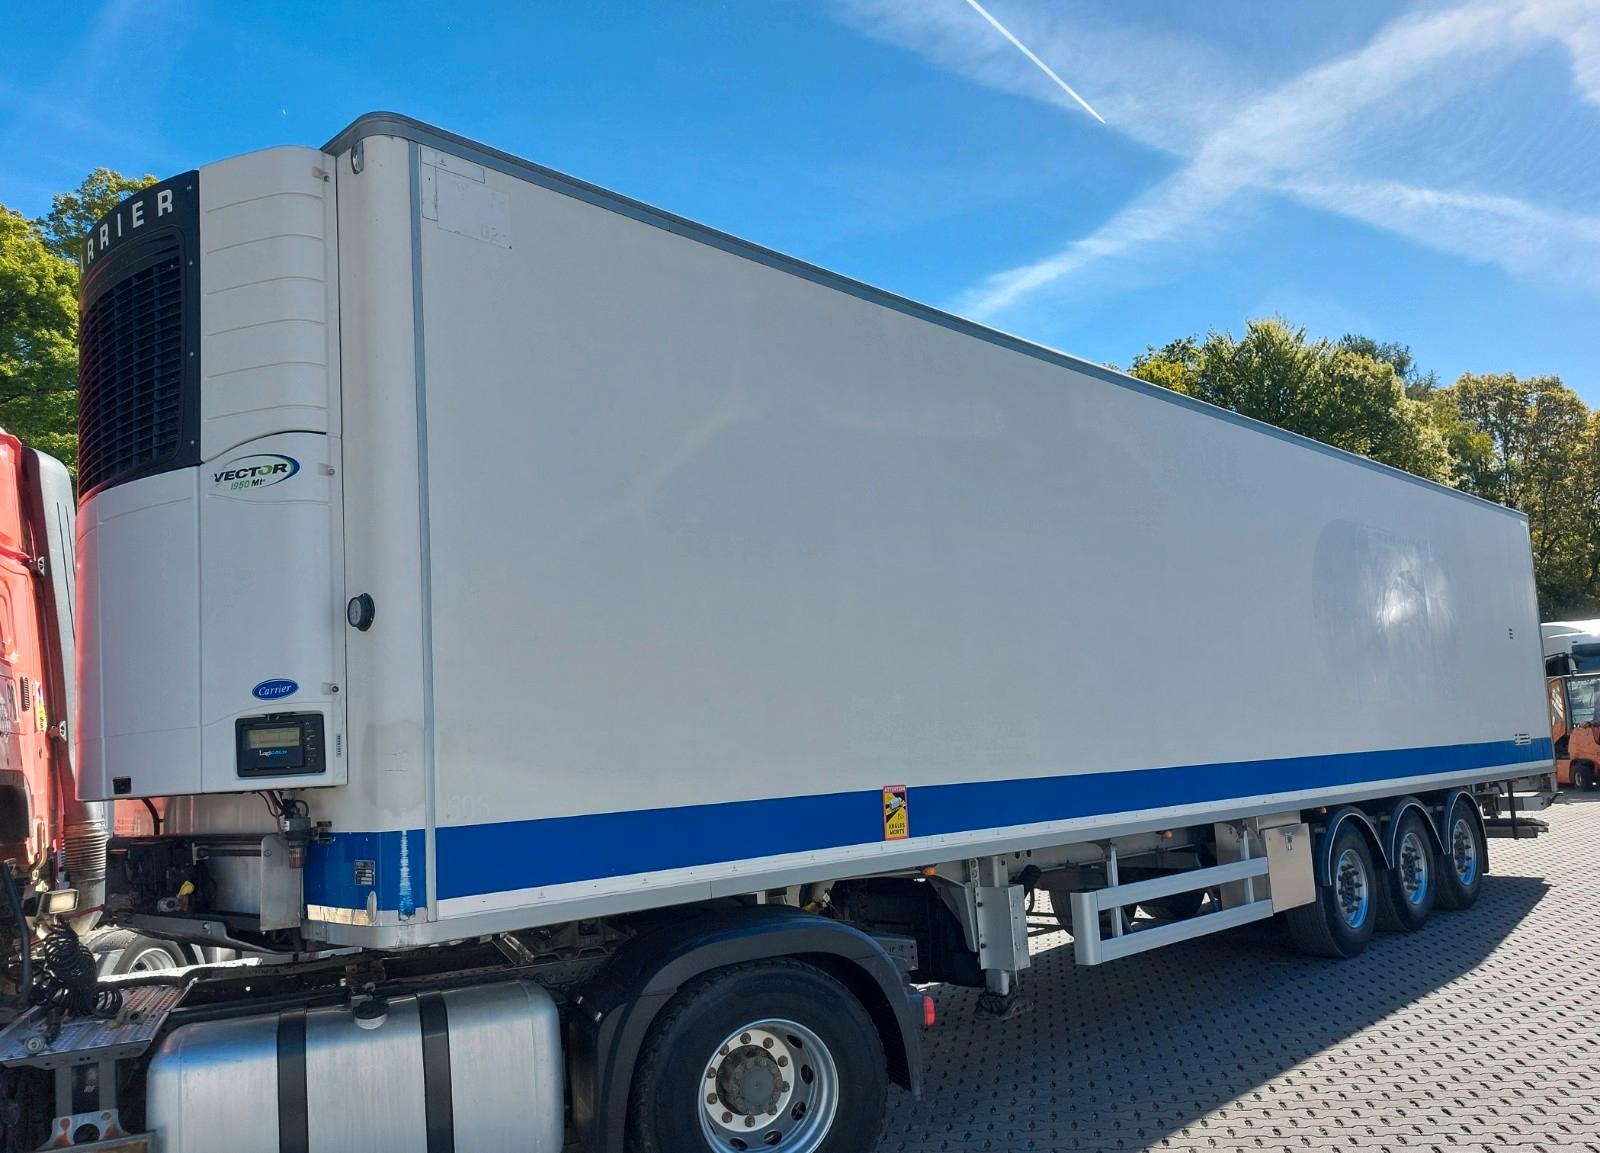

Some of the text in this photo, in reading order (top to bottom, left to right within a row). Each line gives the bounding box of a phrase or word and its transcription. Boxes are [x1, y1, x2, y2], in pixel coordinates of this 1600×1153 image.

[214, 463, 288, 482] VECTOR
[230, 480, 250, 491] 1950
[258, 684, 292, 697] Carrier
